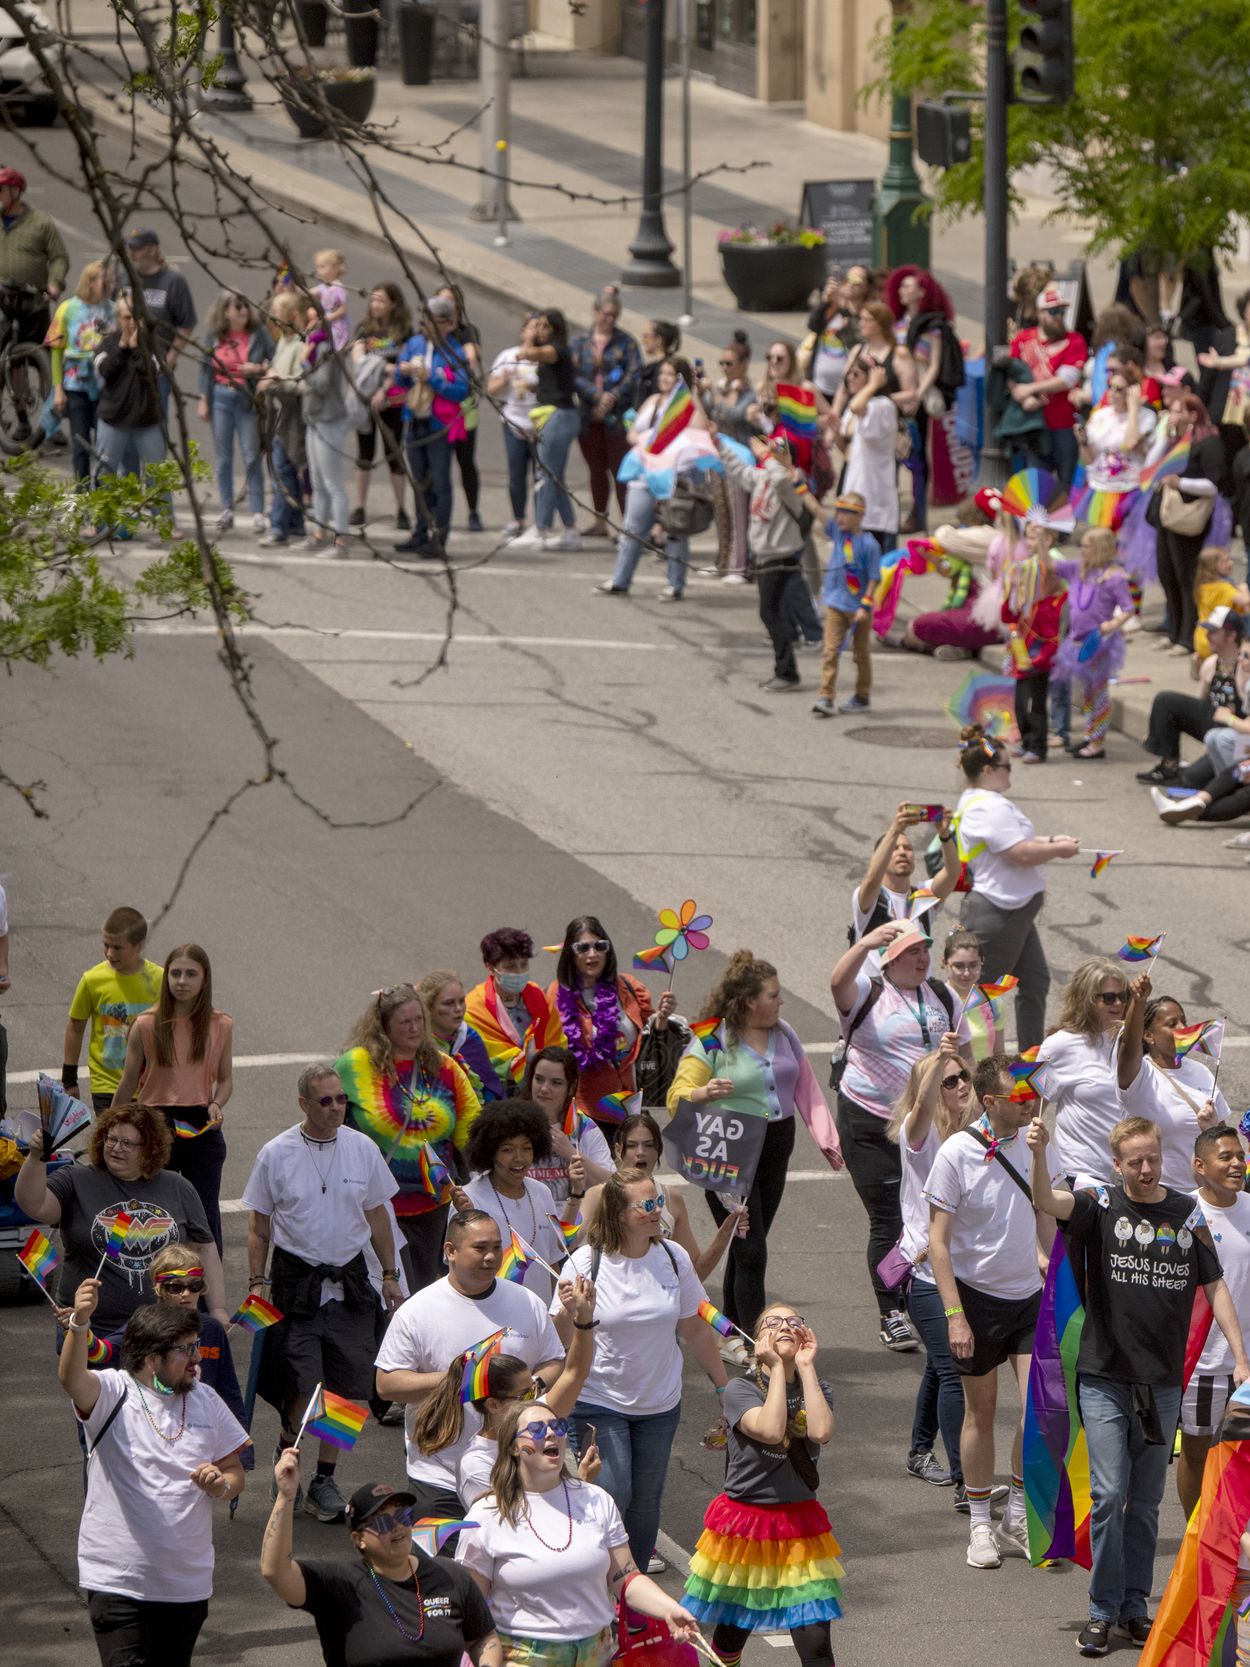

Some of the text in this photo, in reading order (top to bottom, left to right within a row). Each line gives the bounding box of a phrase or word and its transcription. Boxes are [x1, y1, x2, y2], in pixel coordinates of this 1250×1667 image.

[1110, 1253, 1190, 1277] JESUS LOVES
[1111, 1270, 1188, 1292] ALL HIS SHEEP
[423, 1597, 450, 1607] QUEER
[427, 1608, 451, 1618] FOR IT
